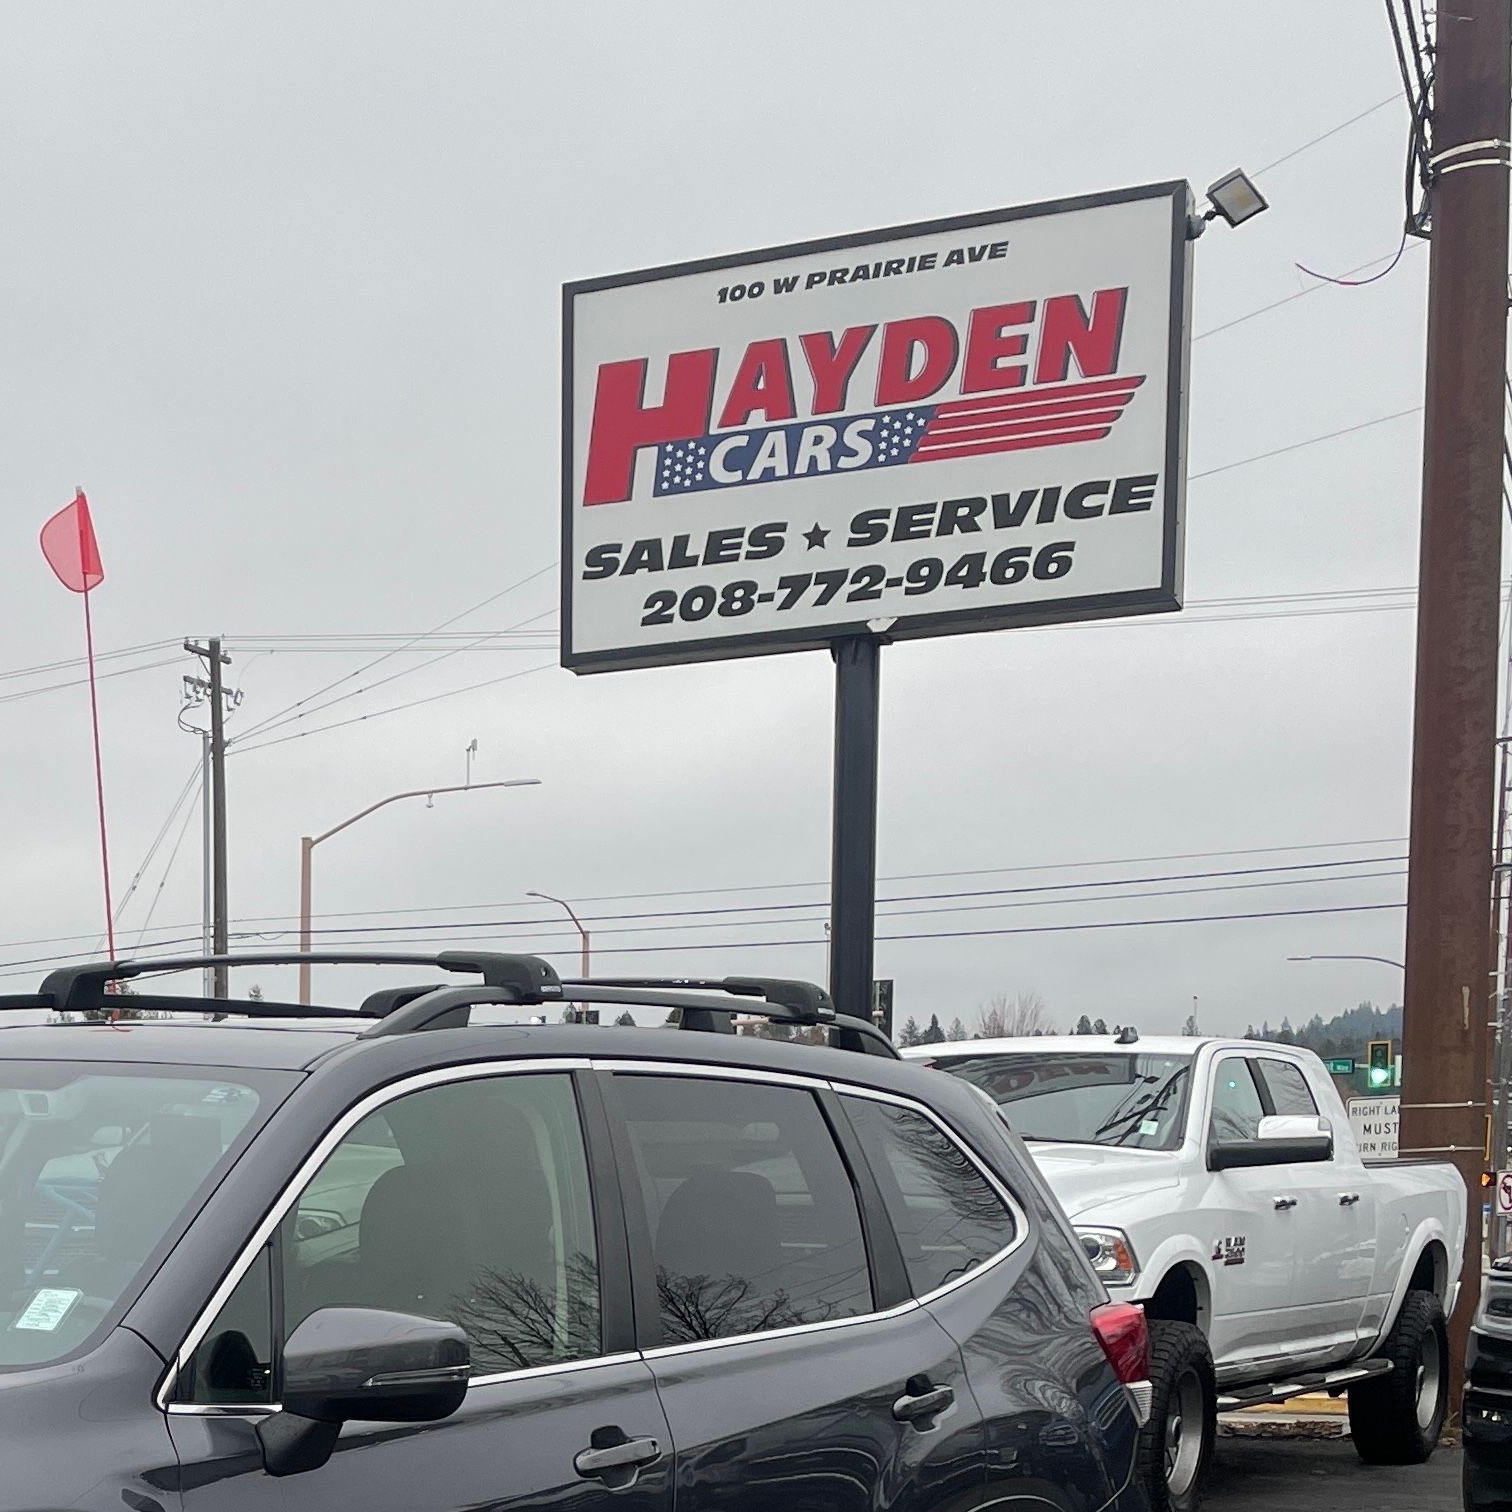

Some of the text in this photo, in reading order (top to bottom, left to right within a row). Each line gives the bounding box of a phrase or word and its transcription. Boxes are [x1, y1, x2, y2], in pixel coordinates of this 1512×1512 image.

[717, 241, 1008, 304] 100 W PRAIRIE AVE
[583, 286, 1129, 507] HAYDEN
[707, 418, 876, 483] CARS
[581, 474, 1158, 580] SALES SERVICE
[640, 541, 1075, 627] 208-772-9466
[1351, 1104, 1400, 1116] RIGHT LA
[1363, 1122, 1399, 1135] MUST
